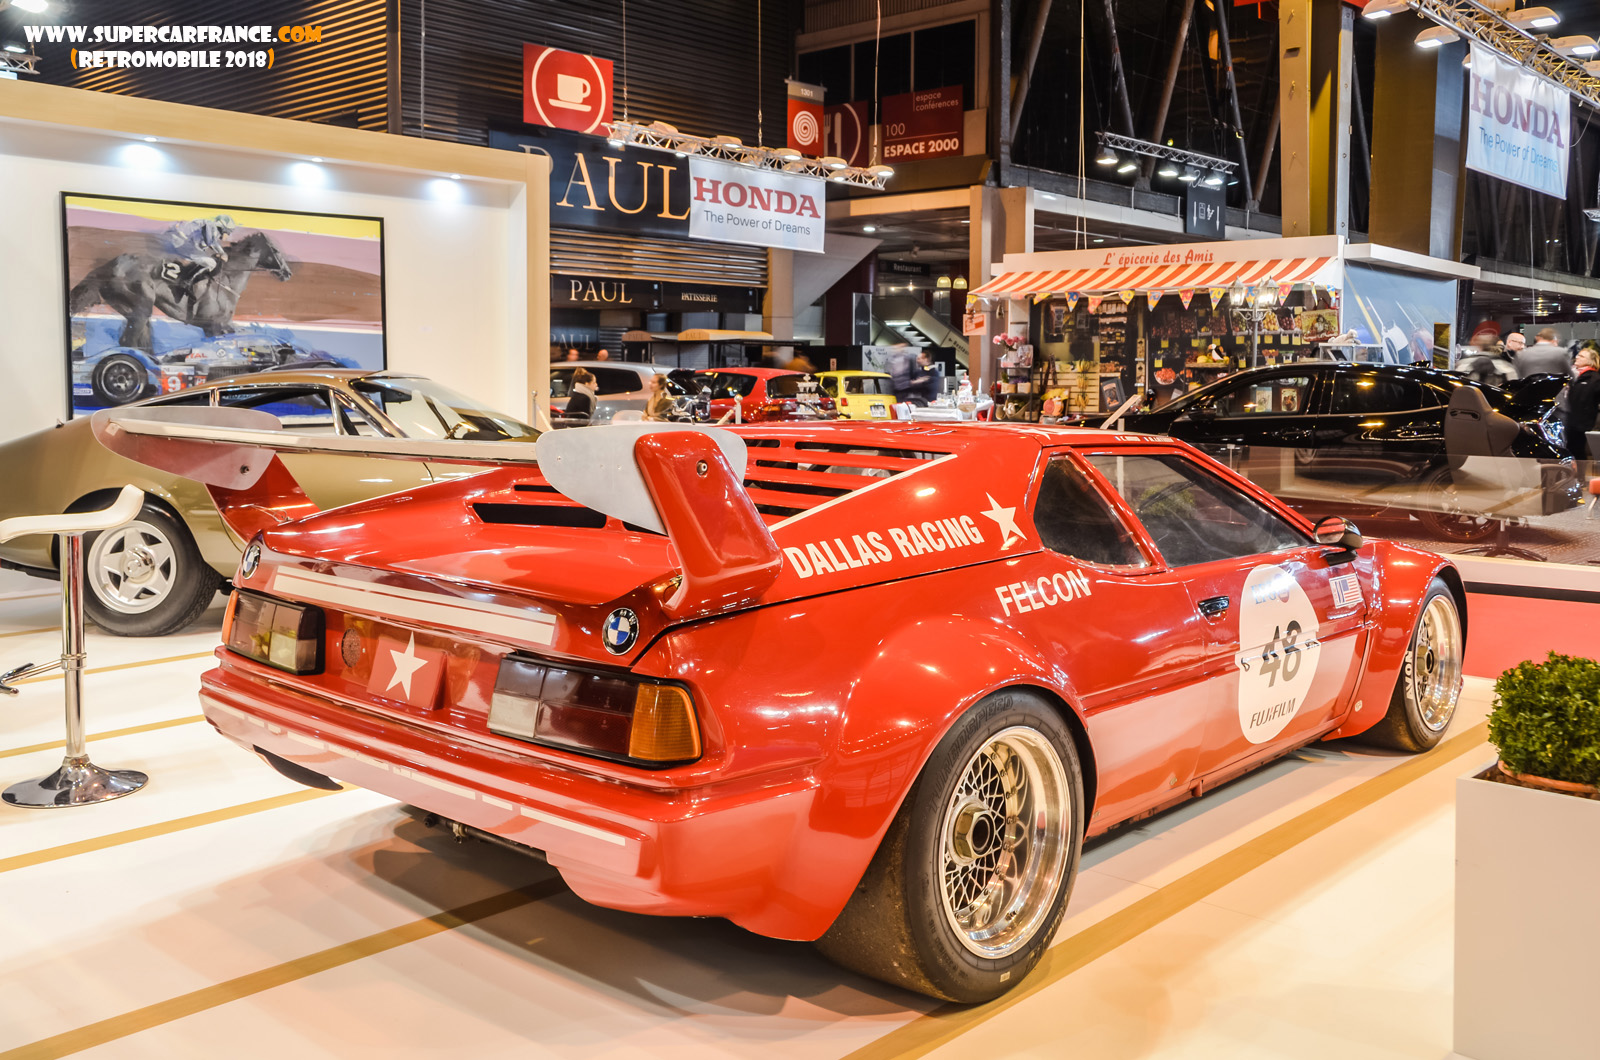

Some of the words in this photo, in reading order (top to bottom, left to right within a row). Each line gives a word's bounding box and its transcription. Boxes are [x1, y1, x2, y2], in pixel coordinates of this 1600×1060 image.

[800, 88, 813, 97] 1301
[915, 92, 942, 103] espace
[915, 98, 959, 112] conférences
[1471, 73, 1565, 149] HONDA
[885, 123, 905, 136] 100
[884, 141, 925, 158] ESPACE
[927, 138, 959, 153] 2000
[1479, 126, 1494, 148] The
[1494, 133, 1521, 158] Power
[1521, 143, 1531, 160] of
[1530, 147, 1559, 172] Dreams
[693, 176, 821, 218] HONDA
[703, 210, 724, 225] The
[726, 213, 759, 229] Power
[761, 217, 773, 231] of
[774, 220, 811, 236] Dreams
[893, 263, 922, 273] Restaurant
[1118, 251, 1160, 268] épicerie
[1163, 250, 1181, 263] des
[1185, 249, 1214, 264] Amis
[569, 279, 633, 304] PAUL
[168, 376, 181, 393] 9
[783, 531, 893, 579] DALLAS
[887, 514, 985, 558] RACING
[995, 569, 1092, 617] FELCON
[1259, 620, 1303, 688] 48
[1404, 650, 1414, 700] AVON
[1250, 697, 1296, 729] FUJIFILM
